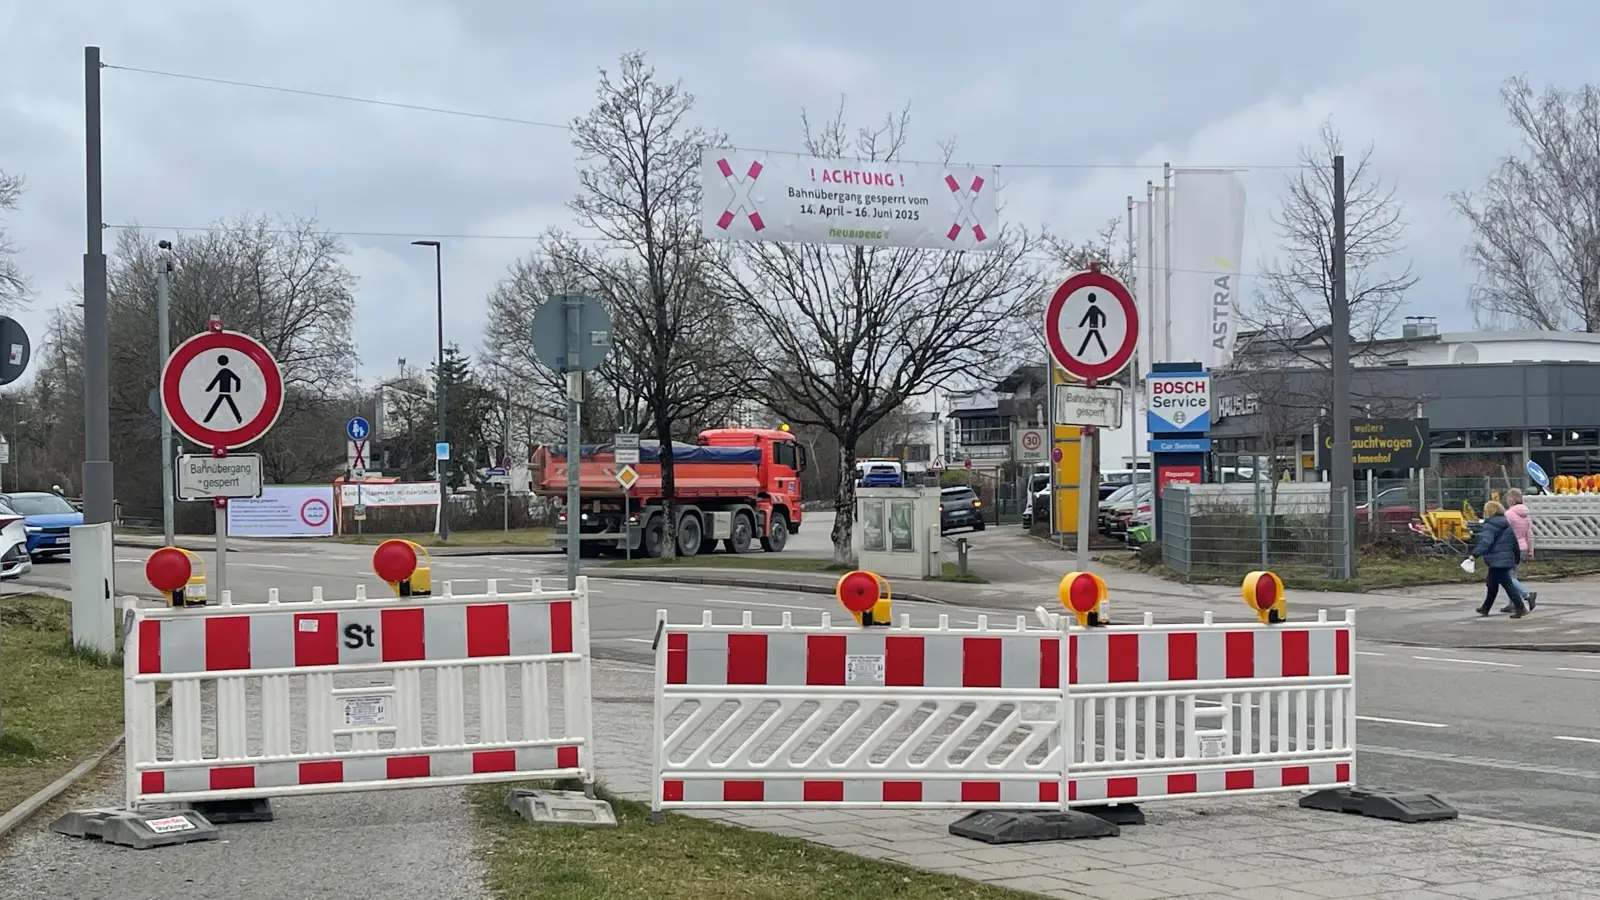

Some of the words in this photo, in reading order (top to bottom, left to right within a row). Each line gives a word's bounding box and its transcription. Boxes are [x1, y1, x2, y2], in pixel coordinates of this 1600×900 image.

[822, 169, 895, 187] ACHTUNG
[788, 187, 863, 204] Bahnübergang
[864, 193, 906, 206] gesperrt
[908, 197, 929, 206] vom
[800, 204, 817, 215] 14.
[818, 205, 845, 217] April
[855, 207, 871, 217] 16.
[872, 208, 893, 219] Juni
[895, 209, 920, 221] 2025
[1212, 274, 1231, 350] ASTRA
[1153, 381, 1205, 395] BOSCH
[1152, 395, 1206, 408] Service
[1026, 436, 1038, 446] 30
[190, 464, 251, 475] Bahnübergang
[203, 478, 239, 489] gesperrt
[344, 623, 375, 649] St
